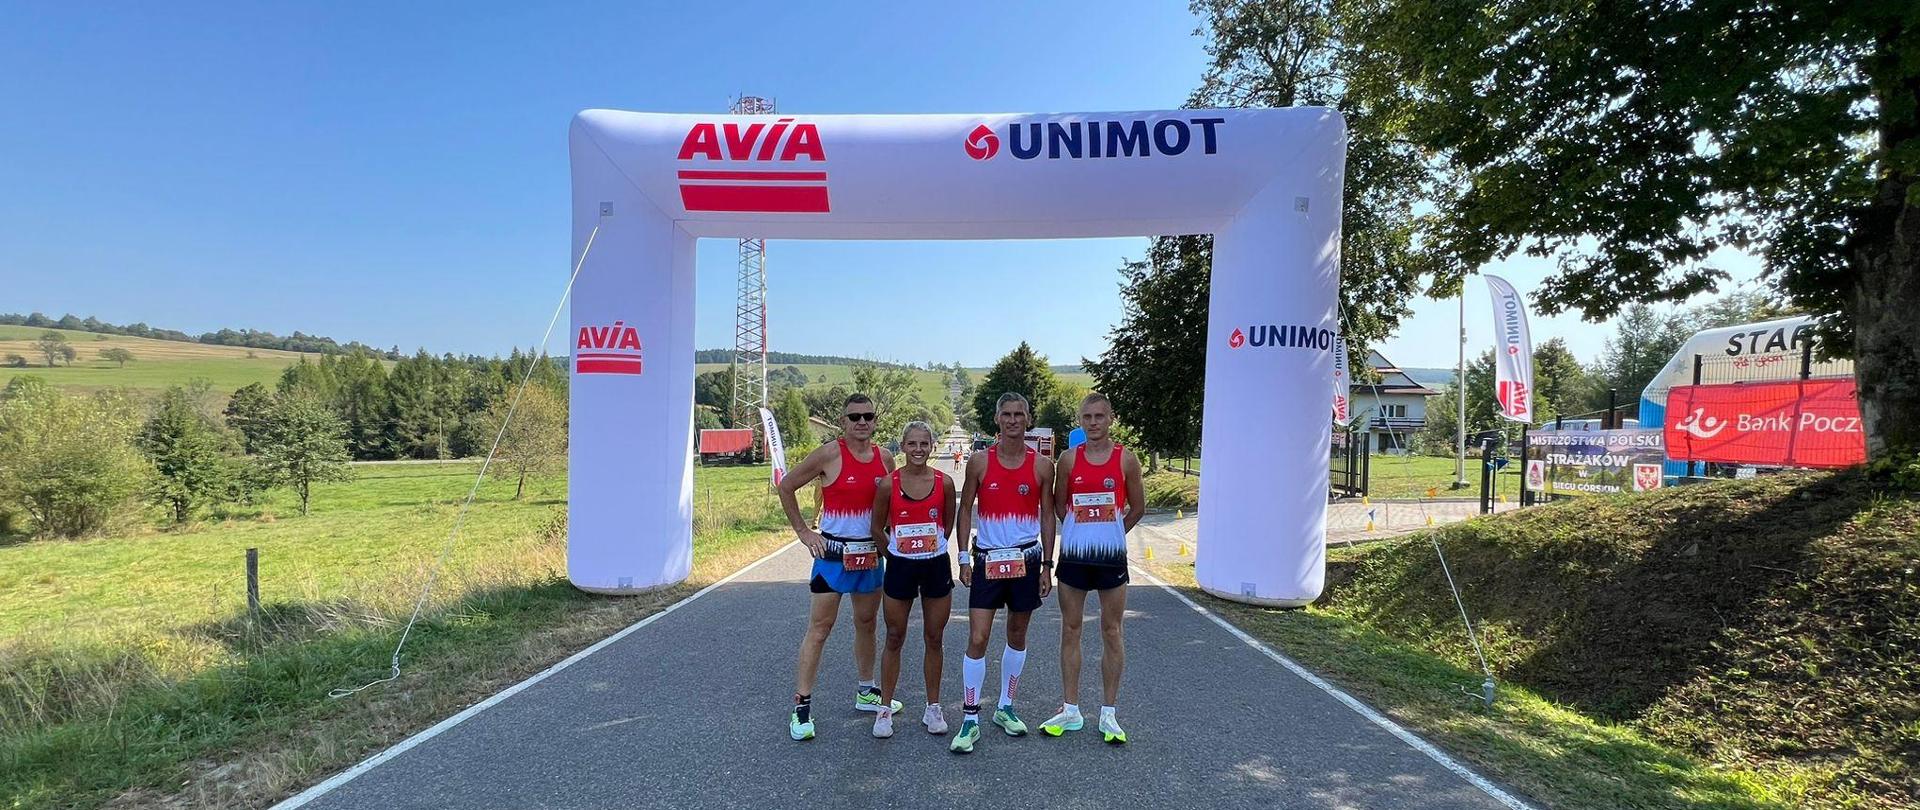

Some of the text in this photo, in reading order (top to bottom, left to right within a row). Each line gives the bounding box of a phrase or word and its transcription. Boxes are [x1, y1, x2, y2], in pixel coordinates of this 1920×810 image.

[1008, 117, 1226, 161] UNIMOT
[1249, 325, 1336, 353] UNIMOT
[1737, 411, 1792, 432] Bank
[1530, 434, 1661, 447] MISTRZOSTWA POLSKI
[1546, 451, 1630, 468] STRAŻAKÓW
[1552, 481, 1620, 493] BIEGU GÓRSKIM
[1088, 508, 1100, 517] 31
[911, 539, 924, 549] 28
[855, 557, 866, 565] 77
[999, 564, 1011, 573] 81
